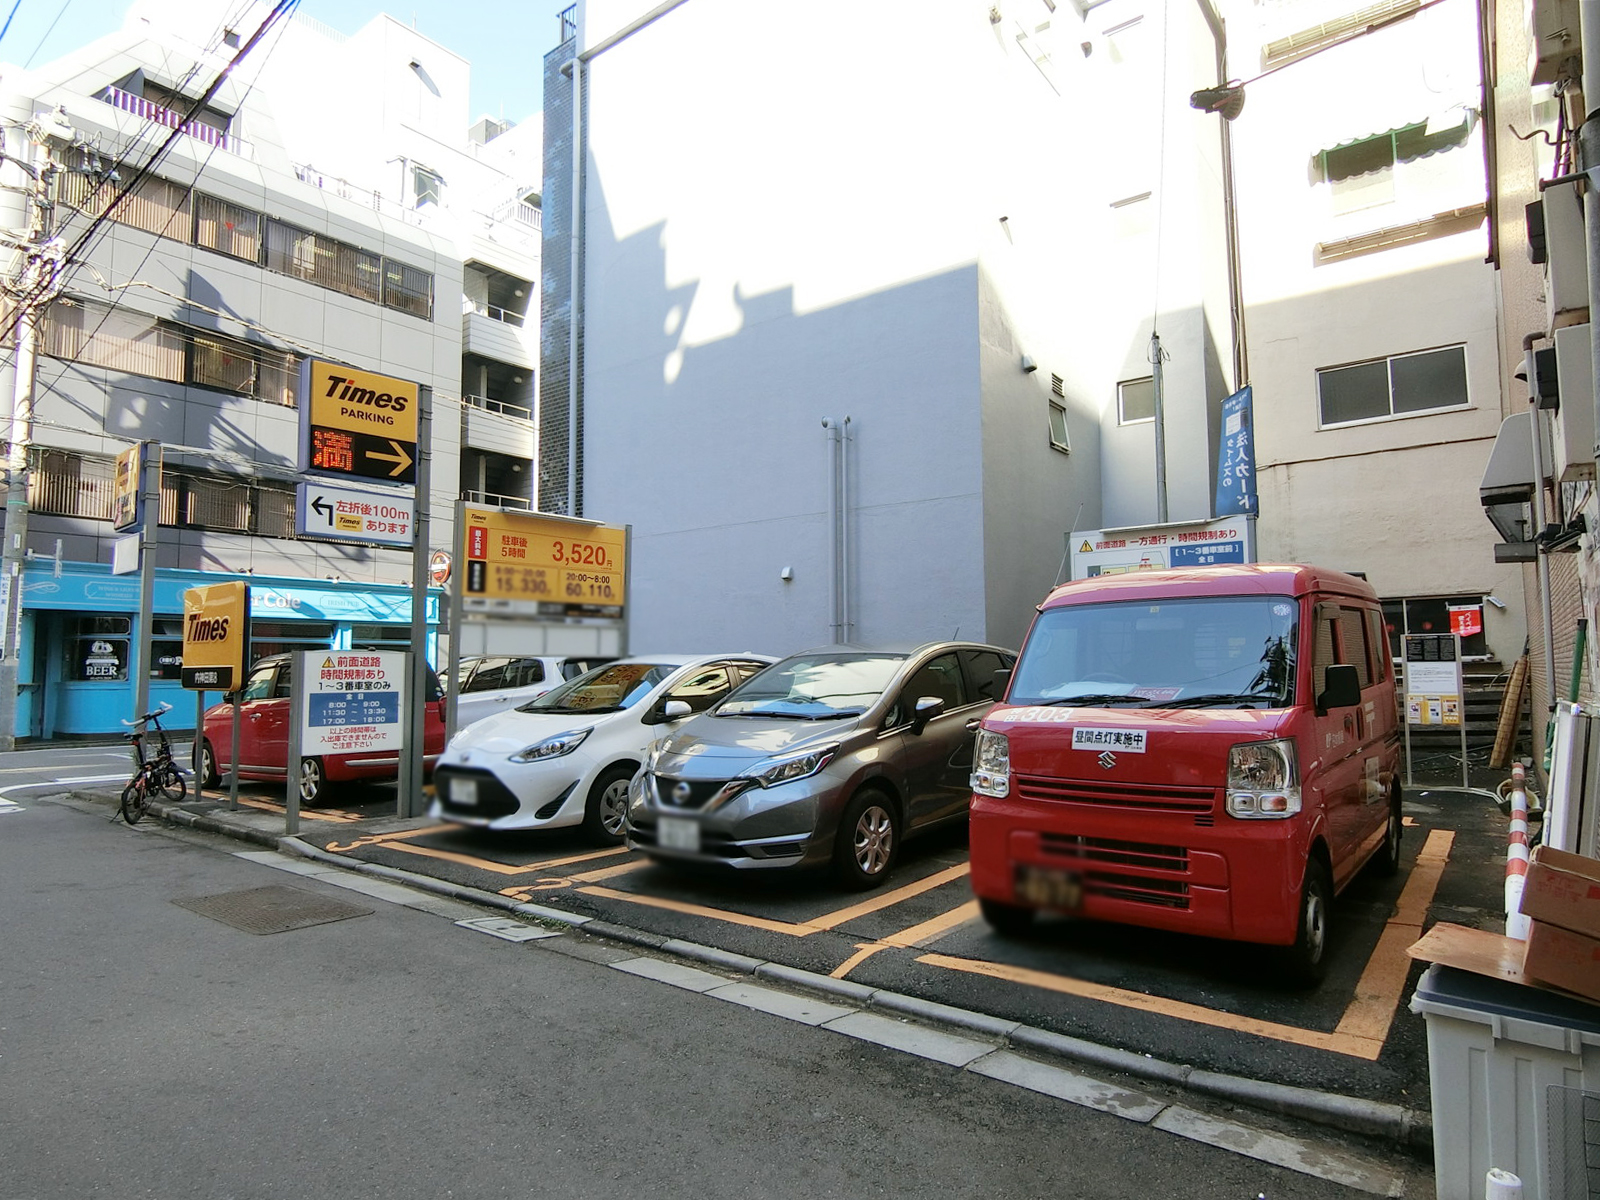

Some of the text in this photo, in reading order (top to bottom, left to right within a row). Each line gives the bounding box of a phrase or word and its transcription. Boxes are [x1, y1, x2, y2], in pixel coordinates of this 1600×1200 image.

[326, 376, 408, 412] Times
[341, 407, 394, 426] PARKING
[314, 430, 352, 471] 満
[336, 500, 410, 520] 左折後100m
[338, 516, 360, 526] Times
[366, 520, 409, 535] あります
[502, 535, 528, 548] 駐車後
[501, 547, 526, 559] 5時間
[264, 592, 302, 609] Cole
[187, 614, 229, 642] Times
[338, 656, 381, 668] 前面道路
[86, 666, 118, 676] BEER
[320, 669, 385, 680] 時間規制あり
[1020, 706, 1074, 722] 303
[1074, 730, 1144, 746] 昼間点灯実施中
